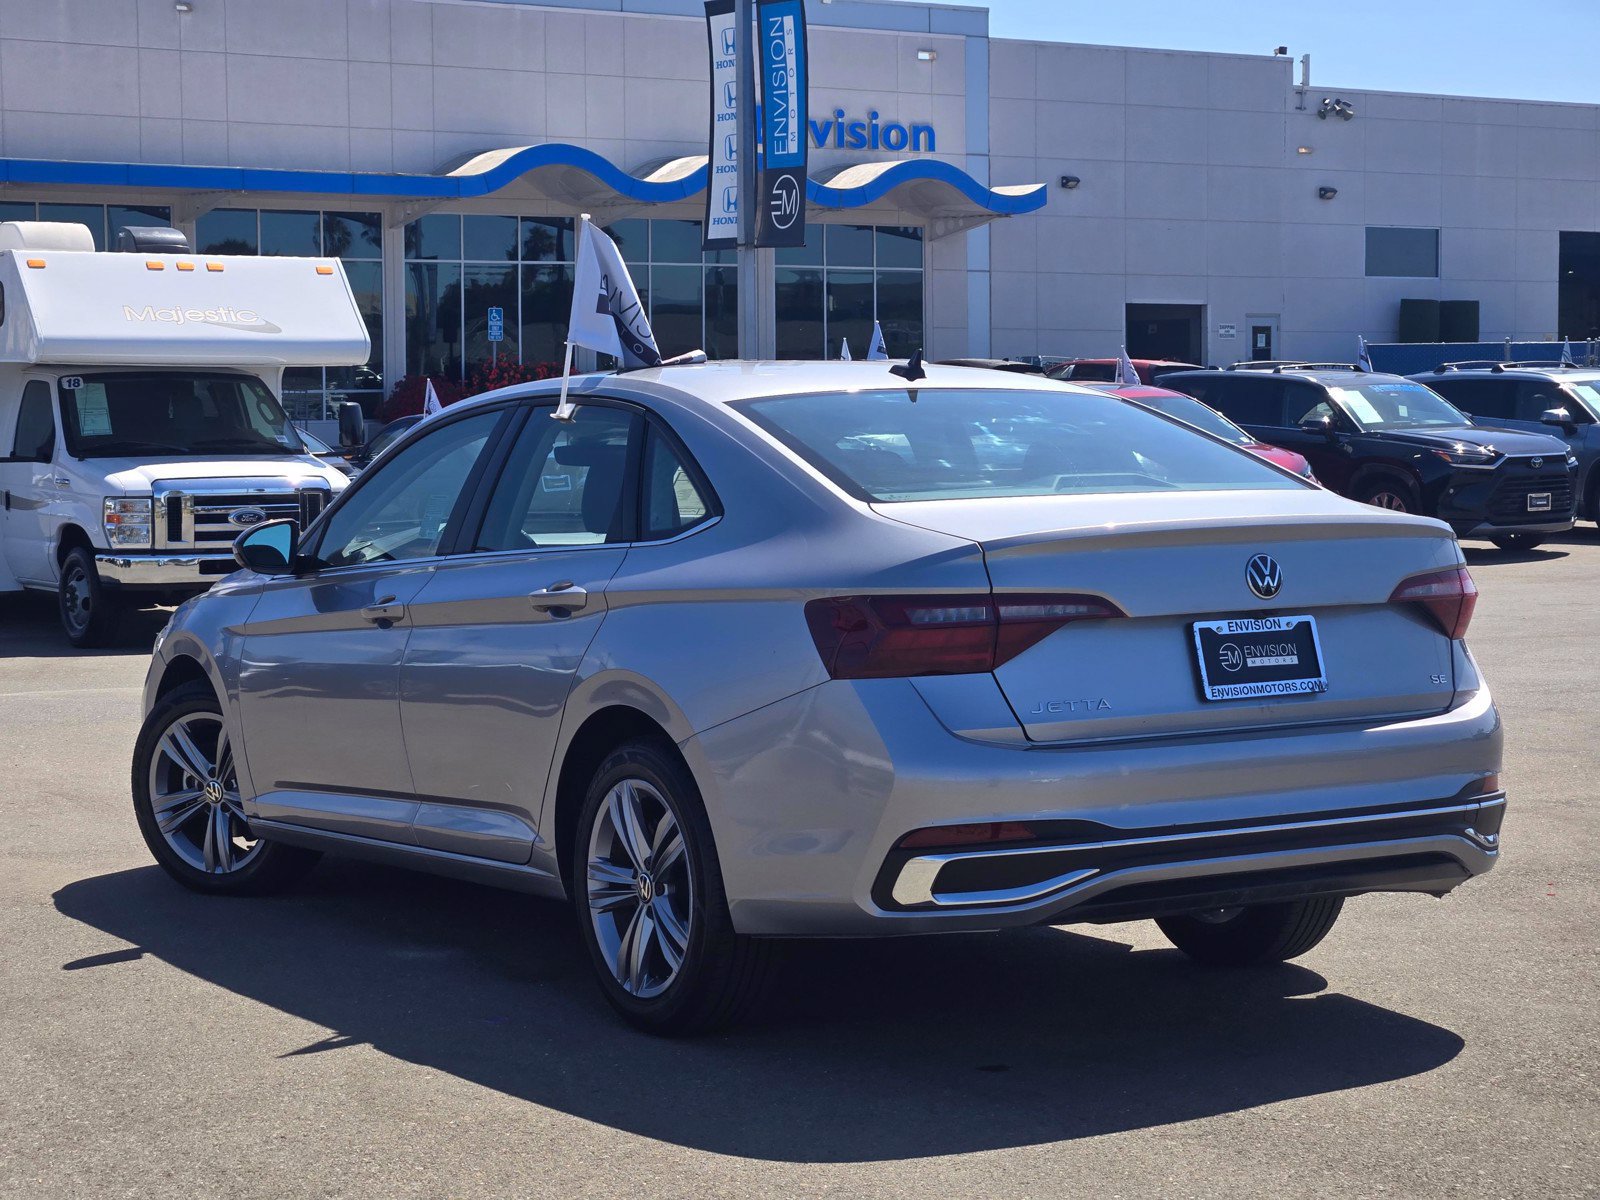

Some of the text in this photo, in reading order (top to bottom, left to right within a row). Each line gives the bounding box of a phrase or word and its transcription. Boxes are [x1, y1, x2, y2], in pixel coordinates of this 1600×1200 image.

[716, 60, 736, 69] HON
[769, 16, 788, 155] ENVISION
[786, 28, 797, 142] MOTORS
[717, 111, 736, 122] HON
[809, 109, 936, 153] vision
[716, 164, 737, 174] HON
[712, 217, 737, 225] HON
[122, 305, 260, 325] Majestic
[66, 378, 81, 388] 18
[240, 513, 258, 523] Ford
[1227, 619, 1281, 633] ENVISION
[1244, 643, 1298, 657] ENVISION
[1430, 674, 1448, 684] SE
[1211, 680, 1324, 699] ENVISIONMOTORS.COM
[1031, 697, 1112, 714] JETTA
